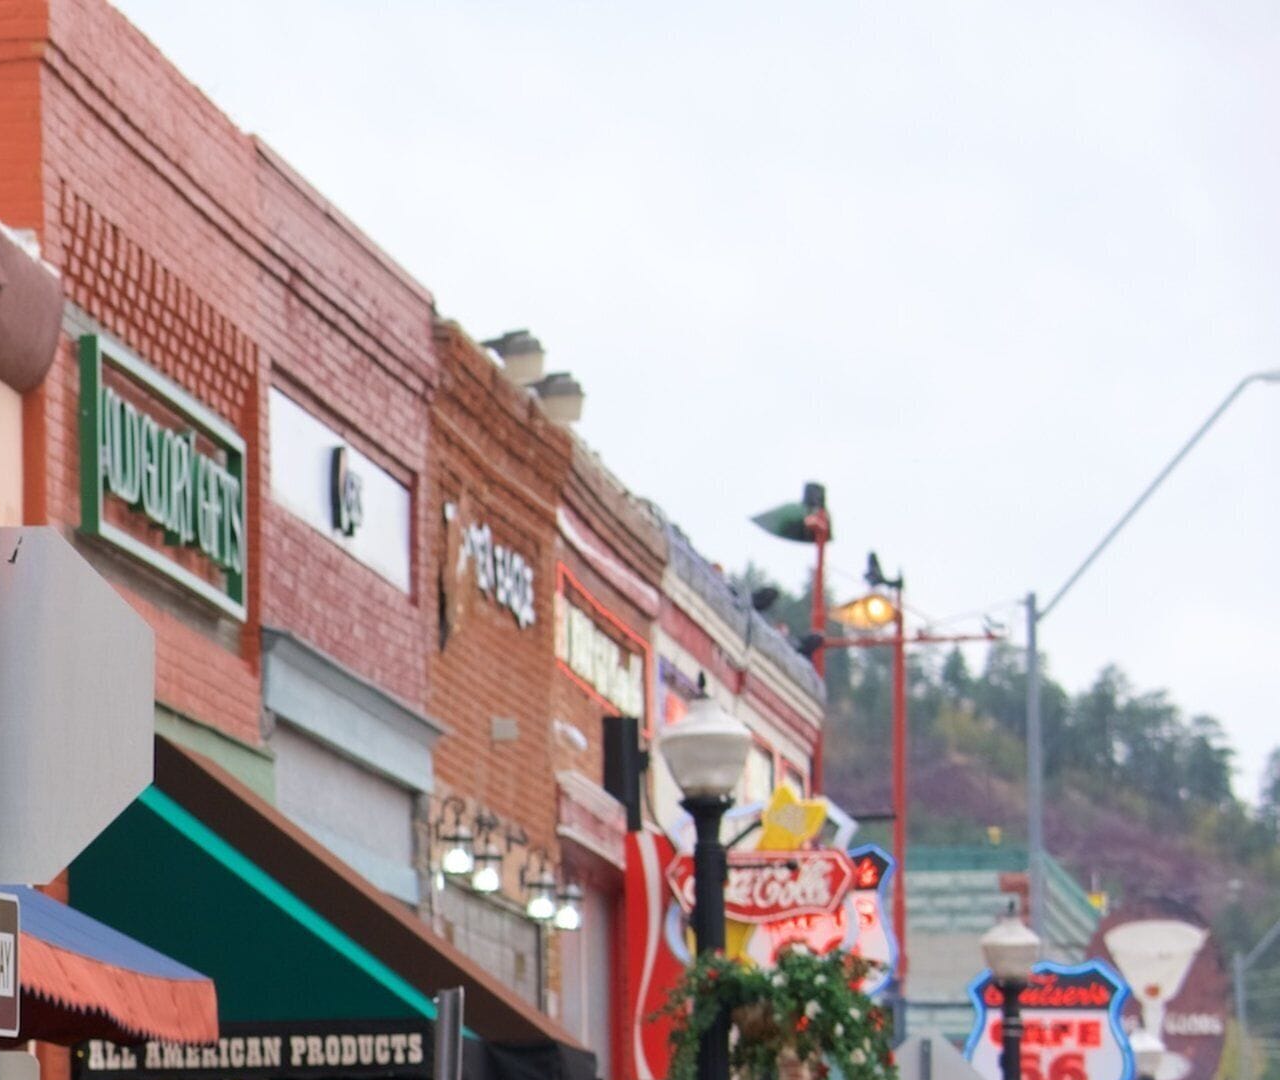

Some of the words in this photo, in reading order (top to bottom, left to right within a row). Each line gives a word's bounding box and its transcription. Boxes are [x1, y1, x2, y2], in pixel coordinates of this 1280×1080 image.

[141, 414, 197, 546] GLORY
[198, 454, 243, 575] GIFTS
[88, 1041, 137, 1071] ALL
[144, 1037, 282, 1069] AMERICAN
[290, 1033, 424, 1067] PRODUCTS
